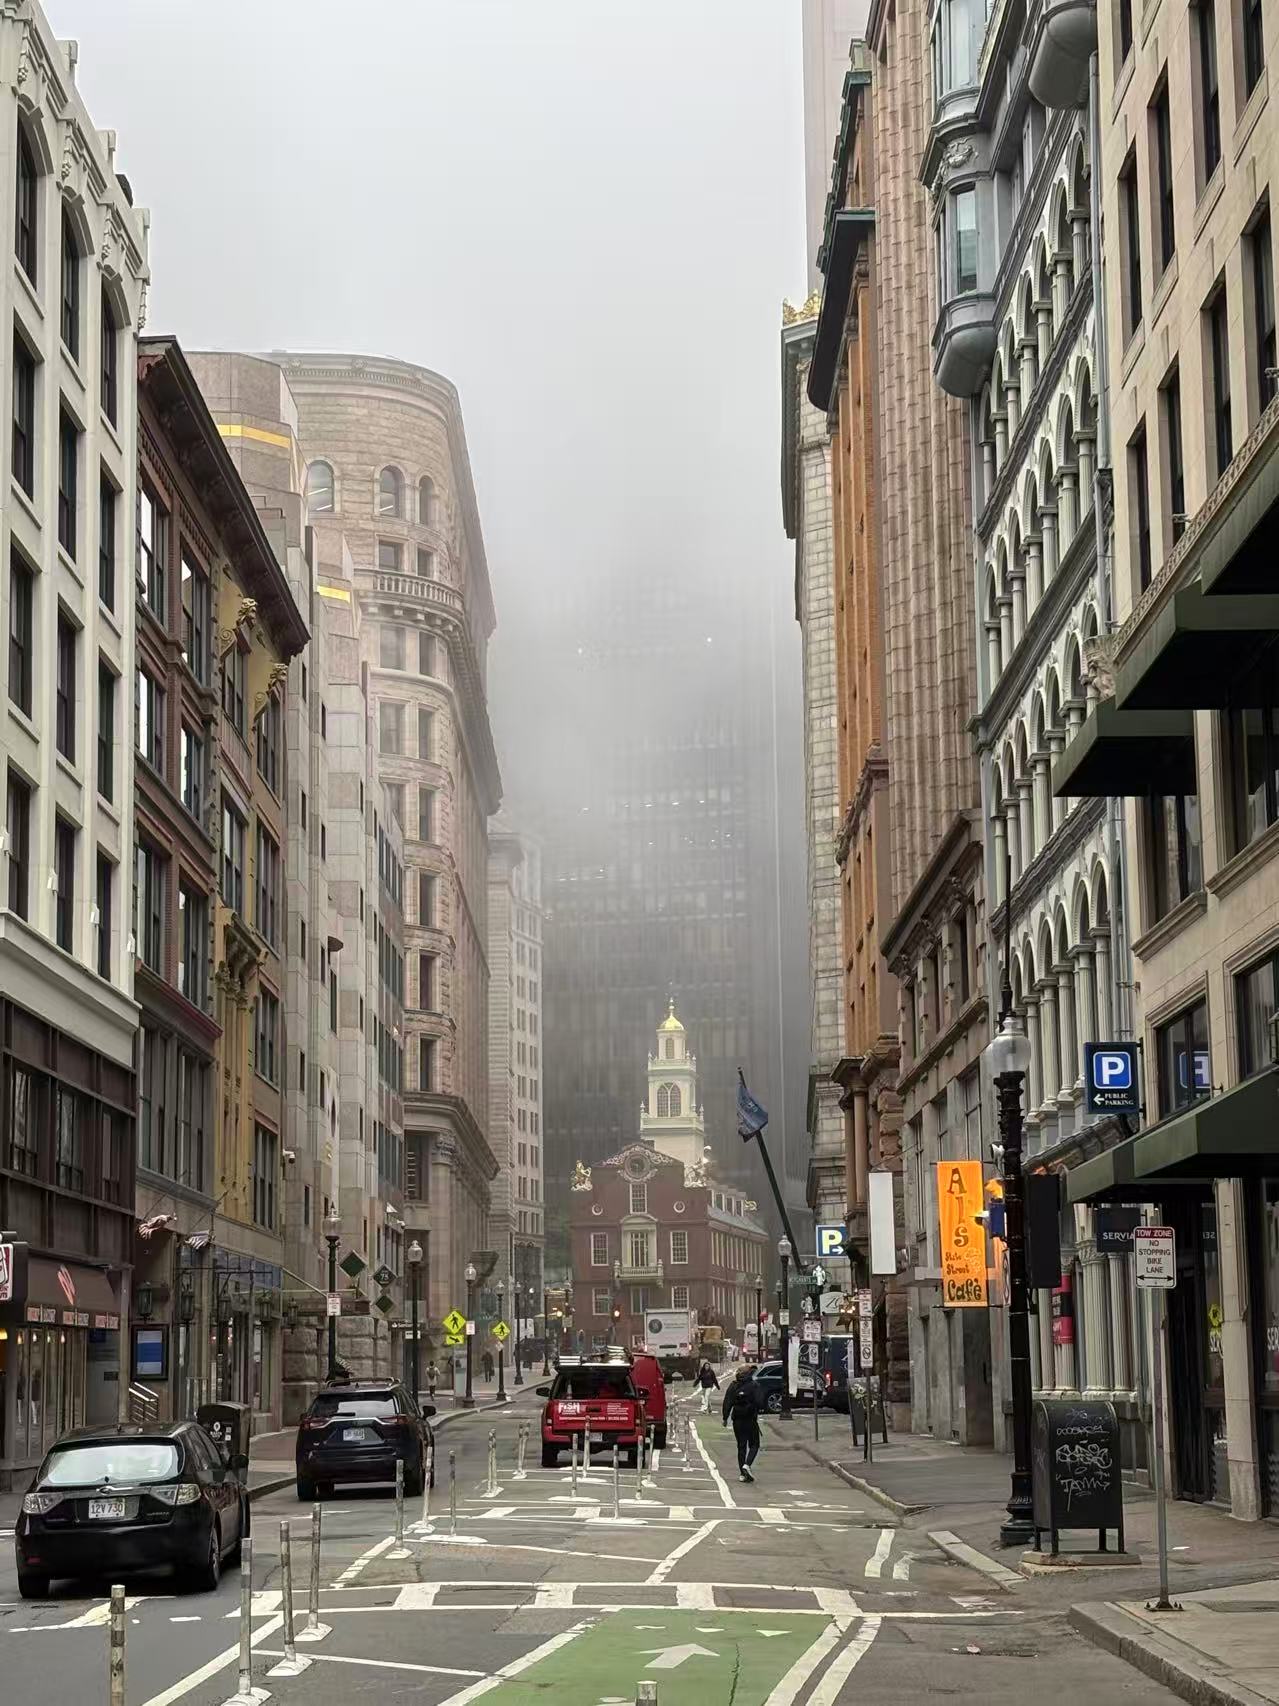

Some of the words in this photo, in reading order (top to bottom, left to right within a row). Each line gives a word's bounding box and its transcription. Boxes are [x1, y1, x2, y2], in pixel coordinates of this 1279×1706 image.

[1101, 1056, 1125, 1085] P
[821, 1229, 843, 1254] P
[1136, 1229, 1151, 1237] TOW
[1153, 1229, 1172, 1237] ZONE
